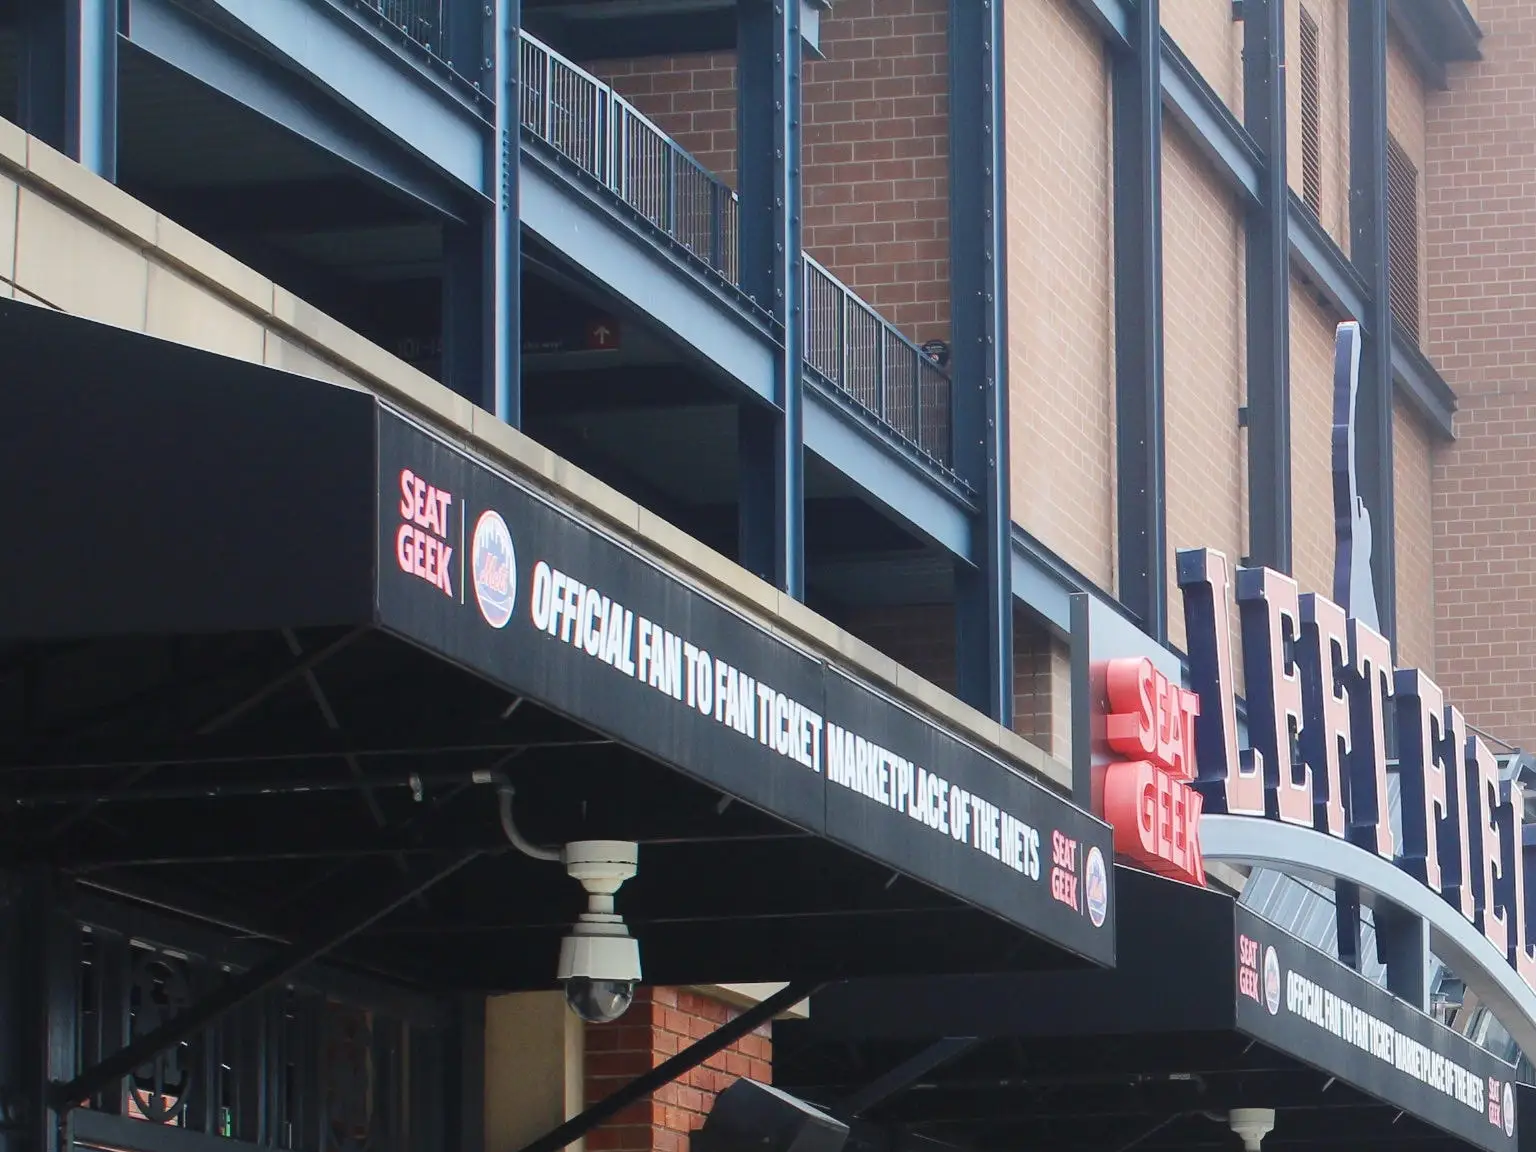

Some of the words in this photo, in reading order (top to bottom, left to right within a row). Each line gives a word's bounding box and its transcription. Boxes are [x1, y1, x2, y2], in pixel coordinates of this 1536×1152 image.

[401, 469, 452, 538] SEAT
[397, 524, 453, 598] GEEK
[531, 560, 635, 677] OFFICIAL
[638, 616, 682, 700] FAN
[684, 641, 713, 716] TO
[715, 658, 755, 739] FAN
[757, 681, 823, 773] TICKET
[827, 721, 949, 835] MARKETPLACE
[950, 785, 970, 844] OF
[971, 793, 1000, 860] THE
[1001, 810, 1040, 881] METS
[1134, 656, 1201, 782] SEAT
[1190, 547, 1395, 861] LEFT
[1052, 830, 1077, 872] SEAT
[1130, 761, 1207, 888] GEEK
[1052, 867, 1078, 912] GEEK
[1240, 934, 1258, 969] SEAT
[1240, 966, 1260, 1003] GEEK
[1287, 969, 1325, 1028] OFFICIAL
[1325, 989, 1341, 1037] FAN
[1341, 999, 1352, 1043] TO
[1353, 1006, 1369, 1052] FAN
[1369, 1015, 1395, 1065] TICKET
